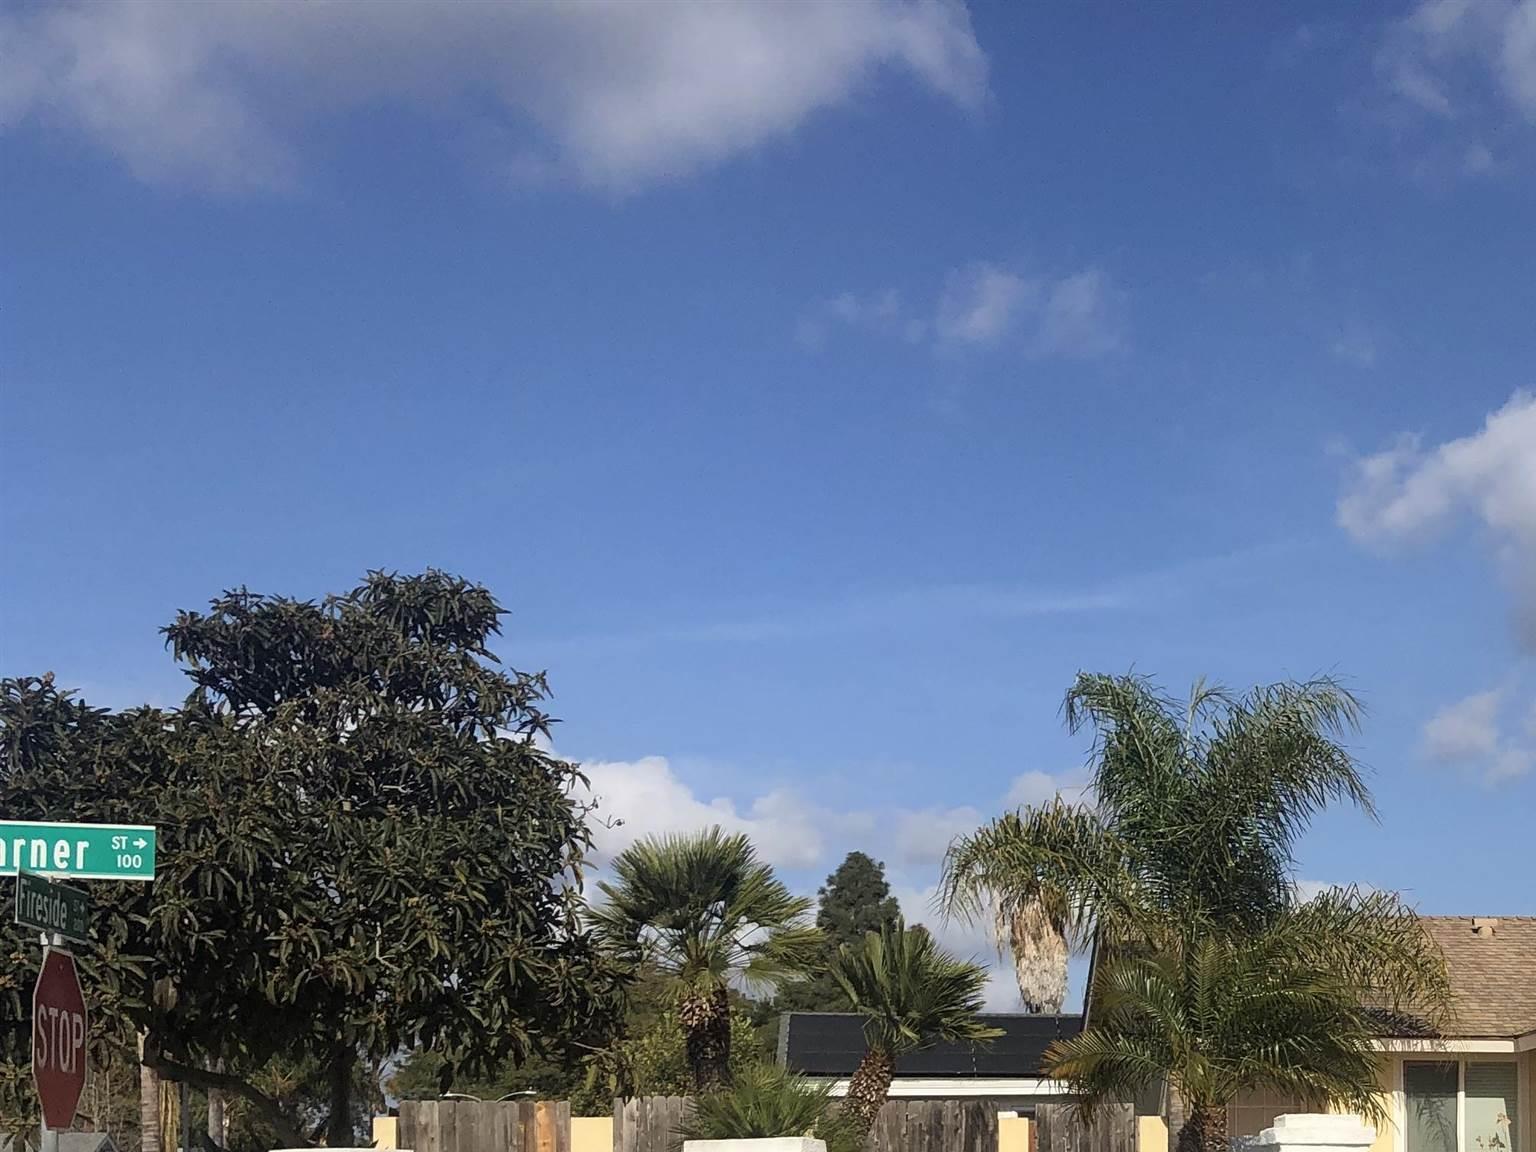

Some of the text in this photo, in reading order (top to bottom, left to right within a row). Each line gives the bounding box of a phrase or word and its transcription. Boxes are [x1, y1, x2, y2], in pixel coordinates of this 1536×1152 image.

[111, 836, 128, 850] ST
[117, 855, 142, 868] 100
[19, 878, 67, 929] Fireside
[37, 1003, 84, 1073] STOP
